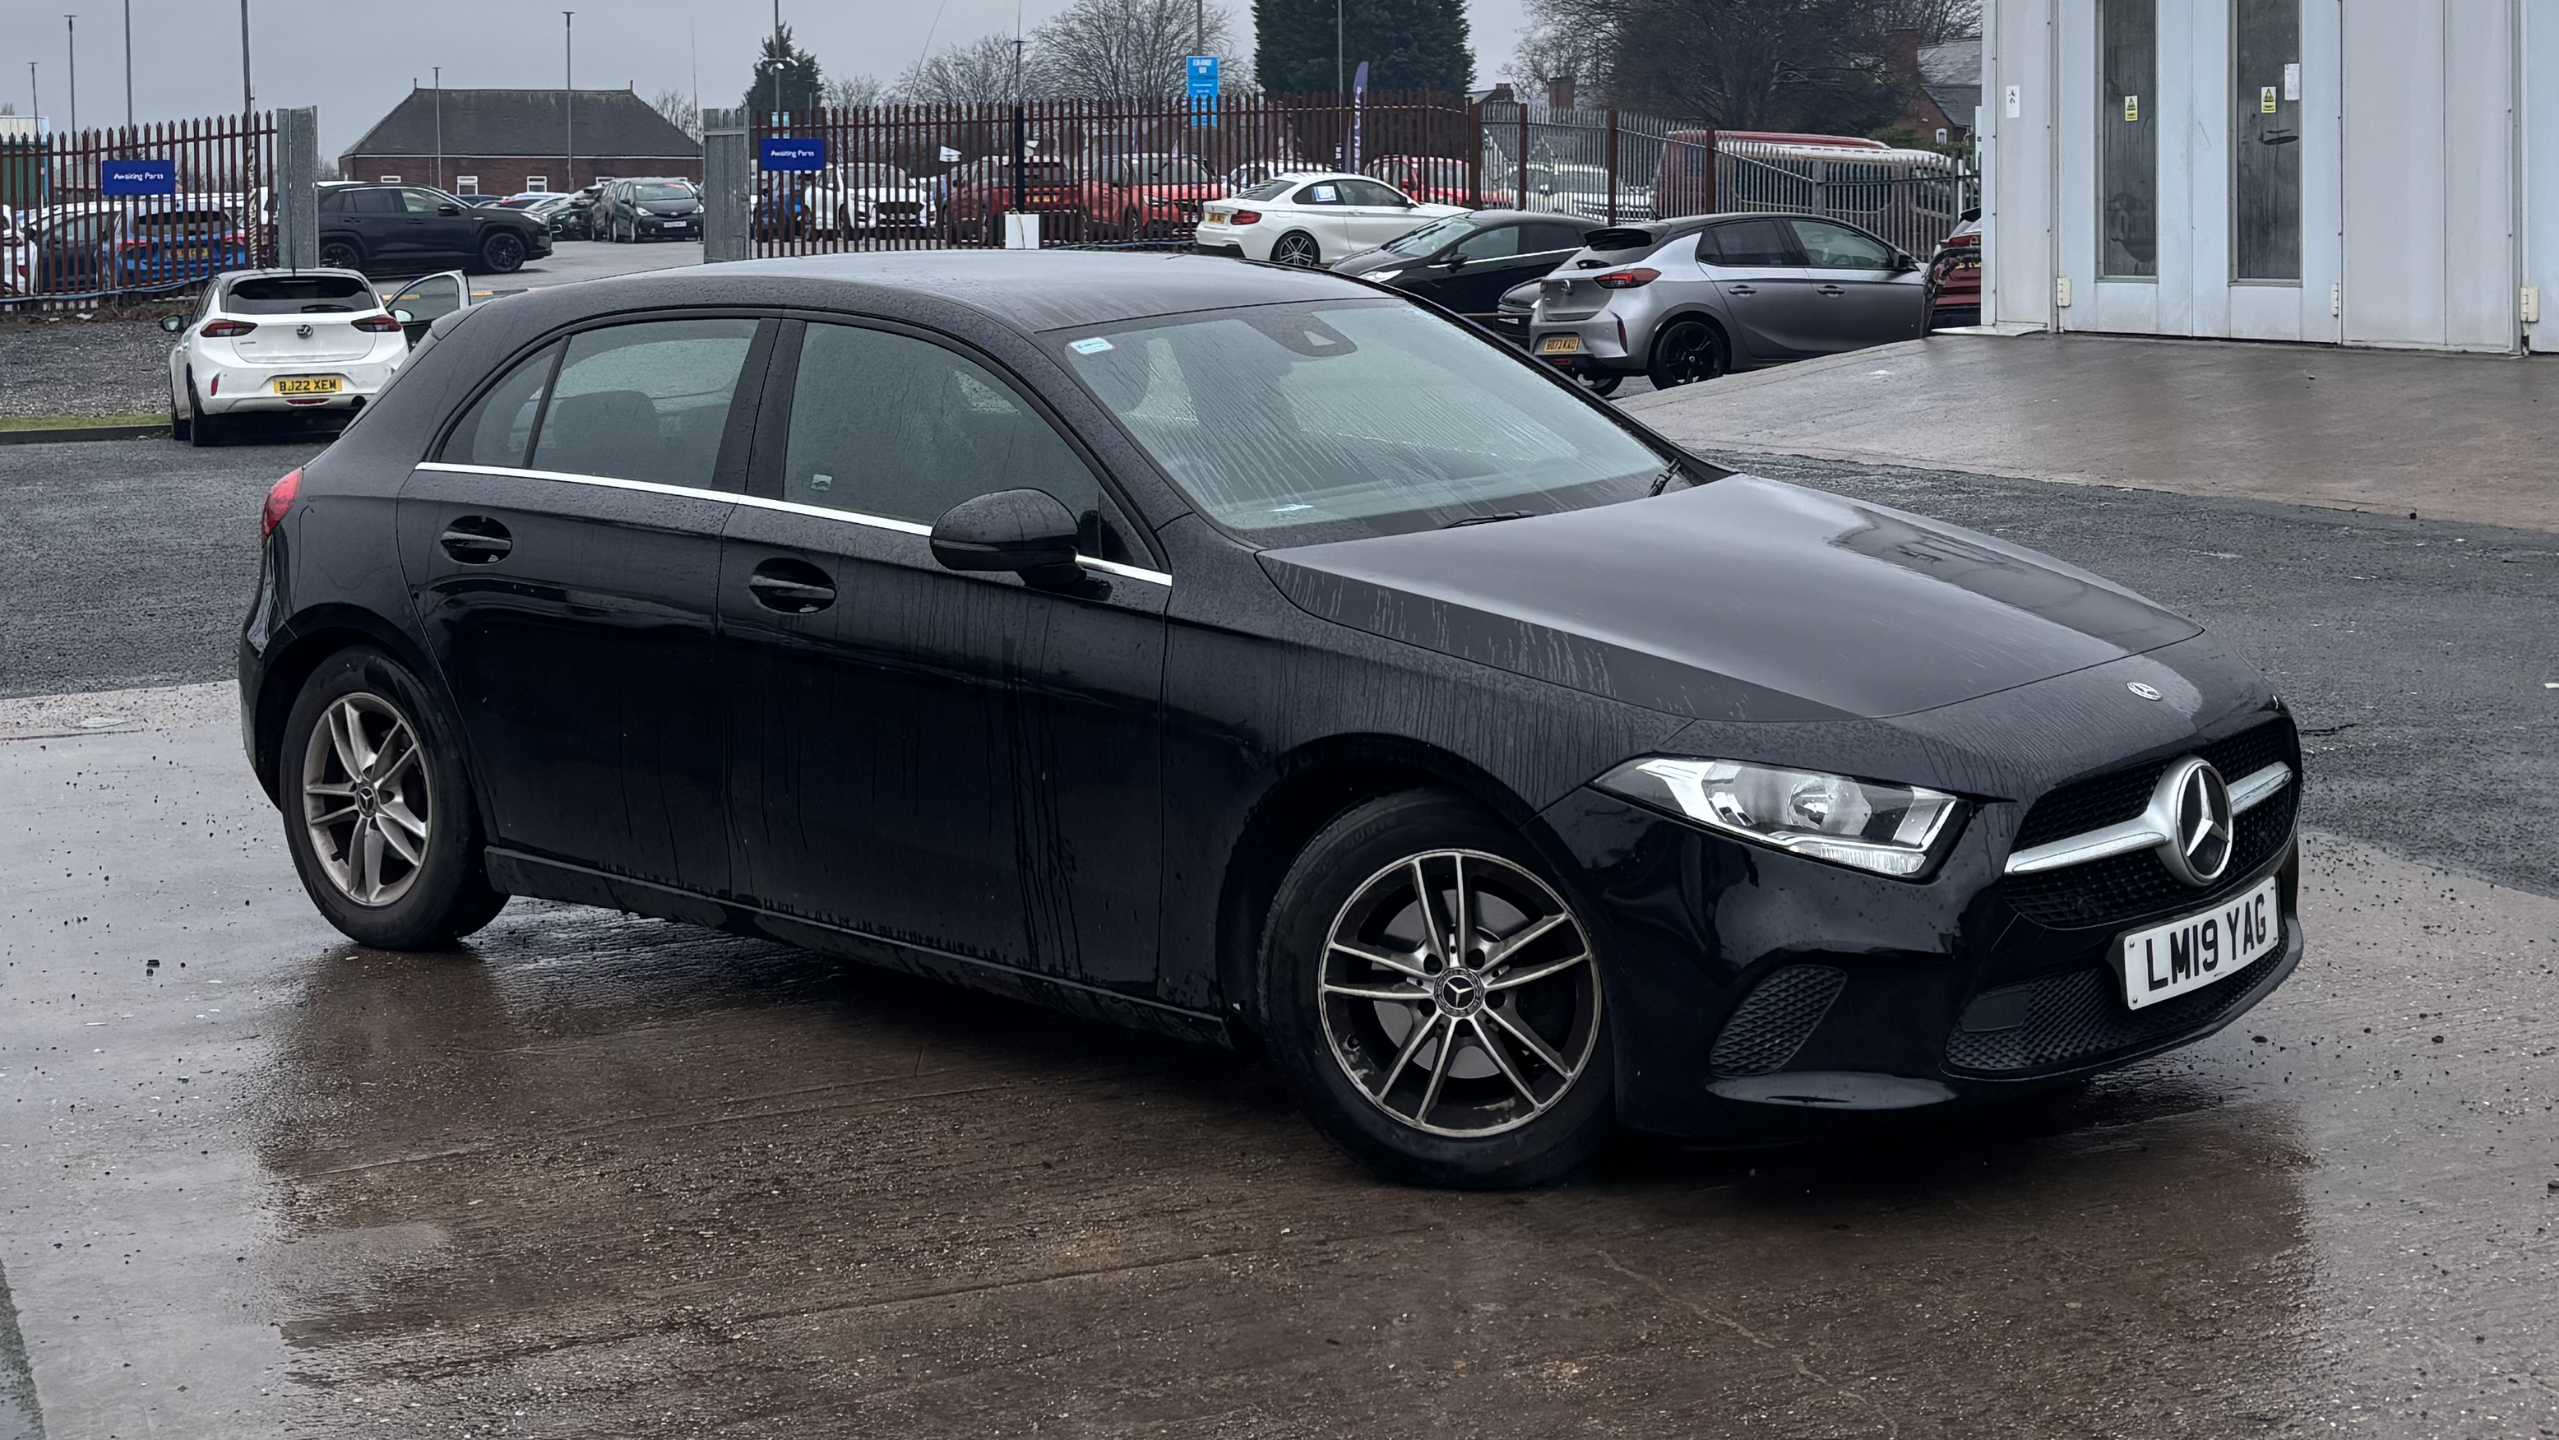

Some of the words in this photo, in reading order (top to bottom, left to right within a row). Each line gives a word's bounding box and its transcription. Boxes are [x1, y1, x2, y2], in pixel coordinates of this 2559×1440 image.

[770, 150, 797, 158] Awaiting
[113, 172, 143, 181] Awaiting
[144, 172, 164, 180] Parts
[279, 380, 310, 391] BJ22
[2146, 918, 2219, 992] LM19
[2226, 893, 2266, 961] YAG
